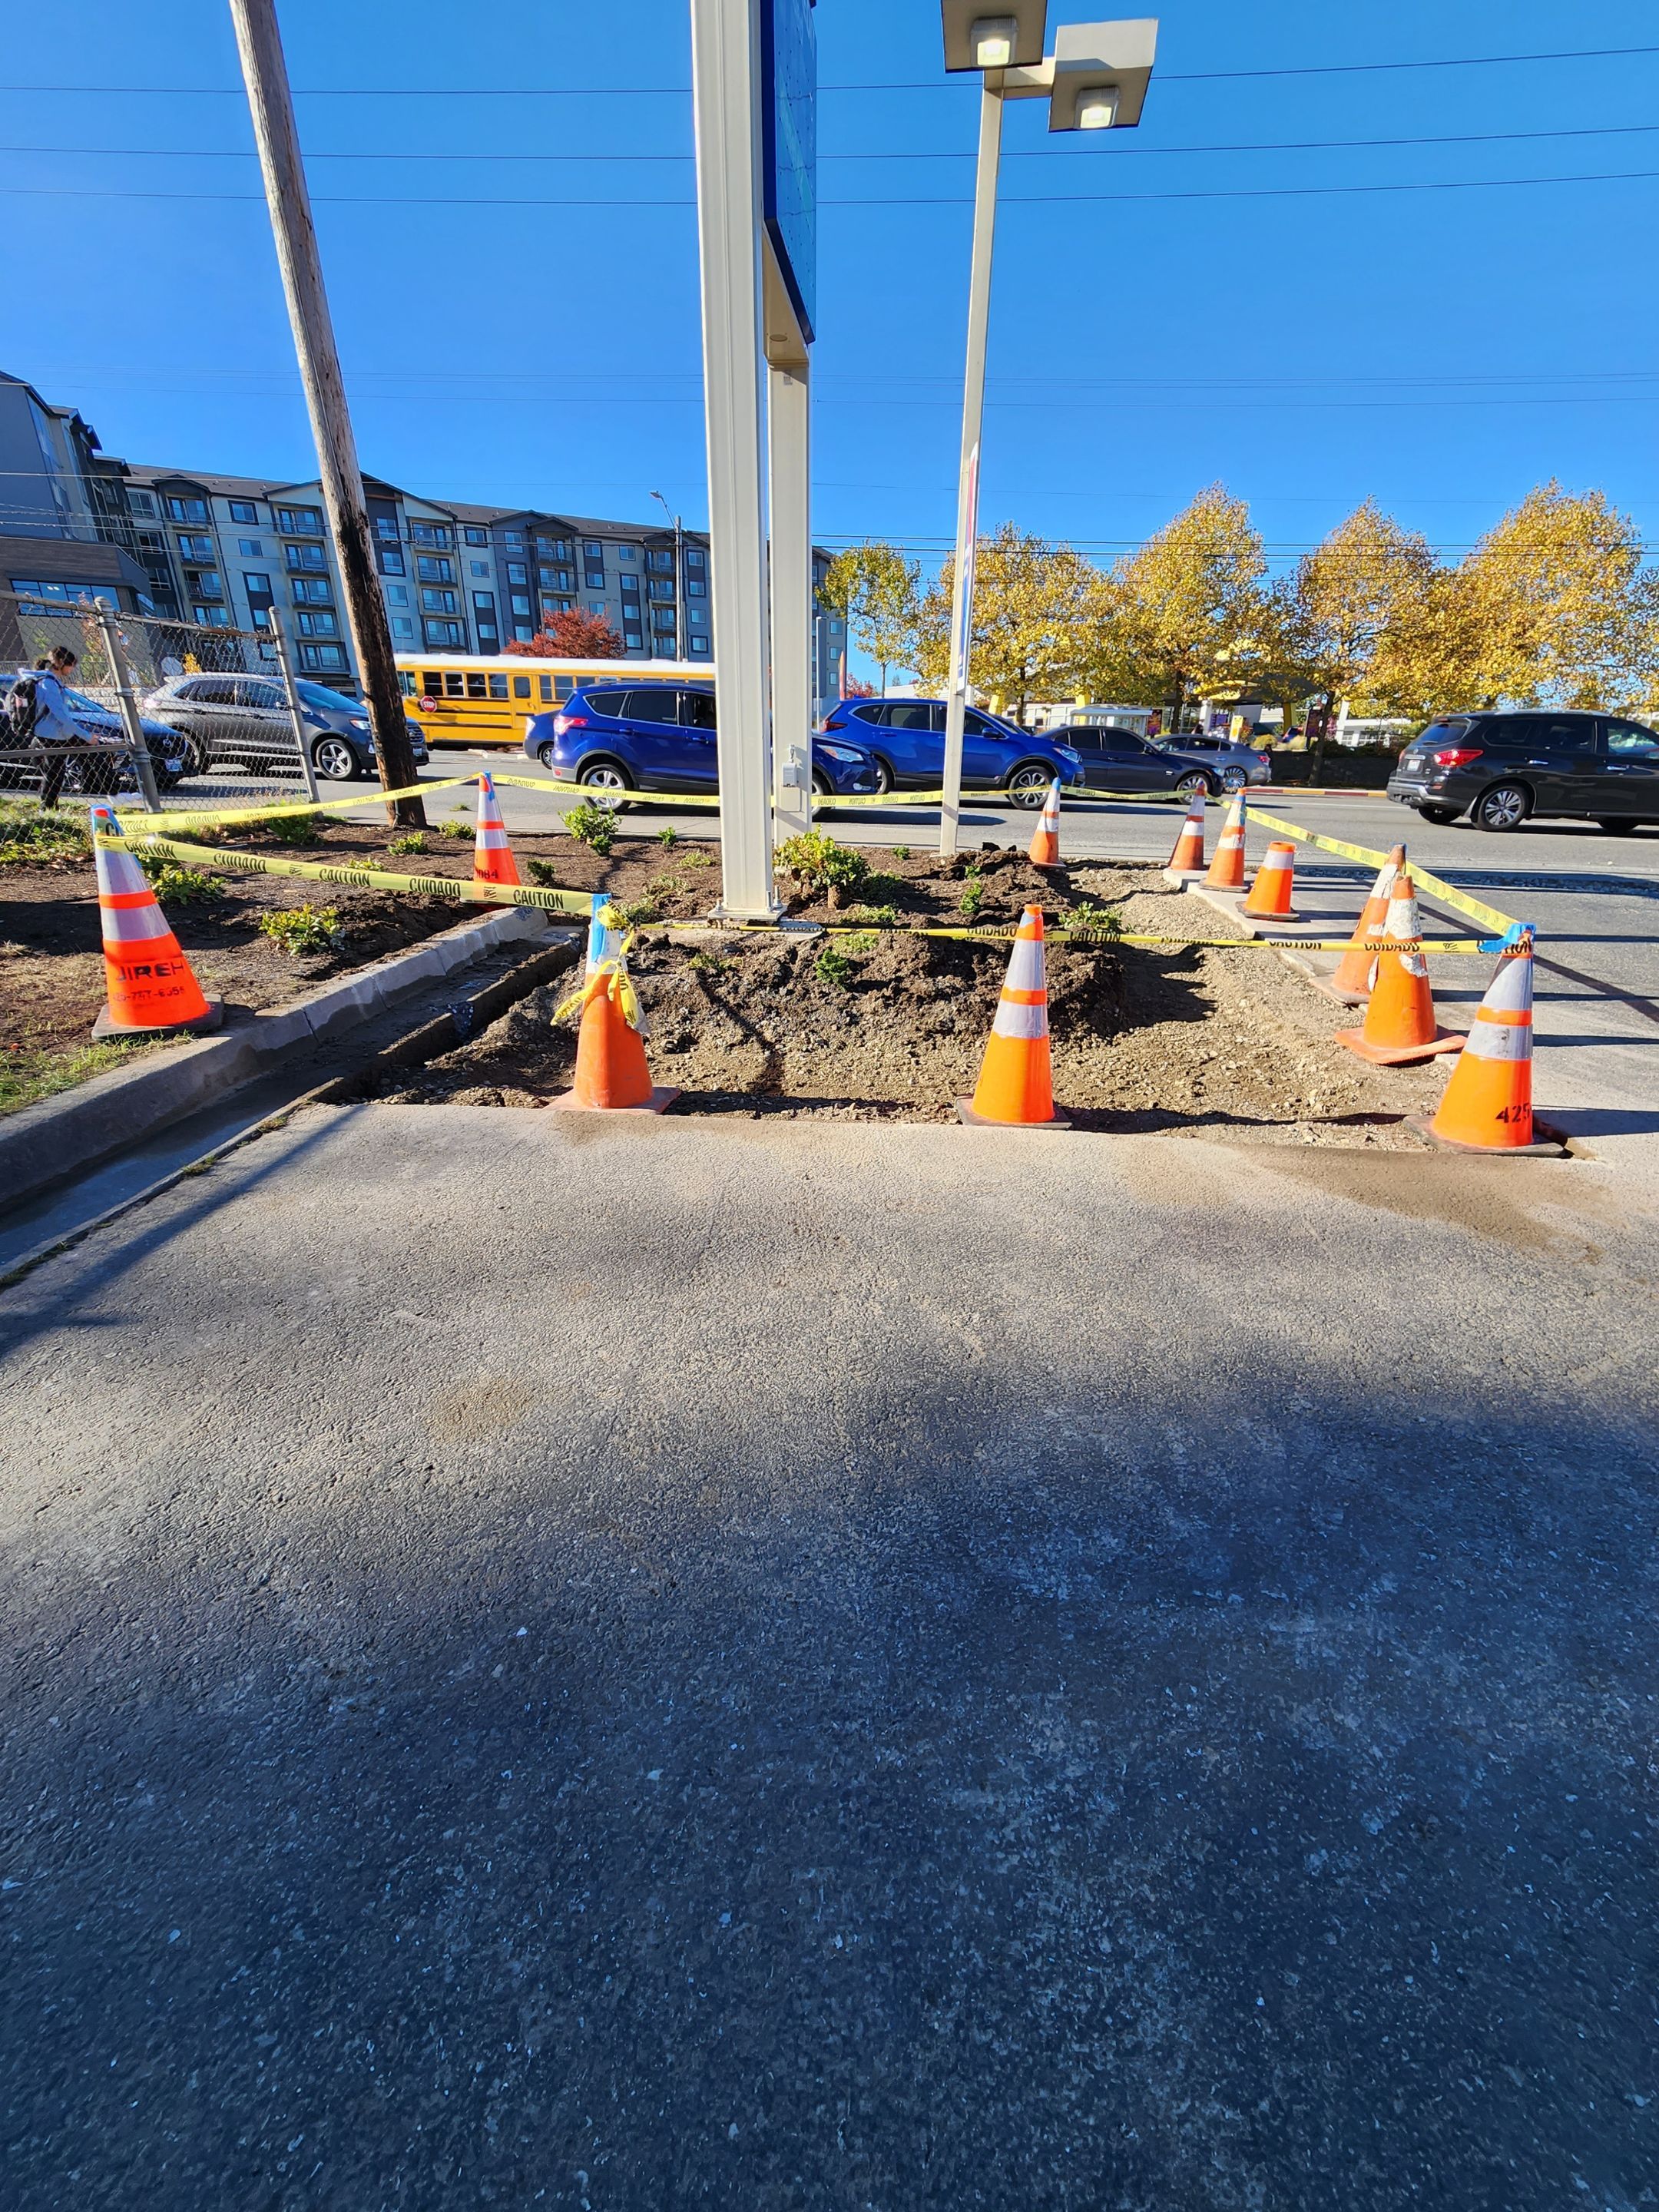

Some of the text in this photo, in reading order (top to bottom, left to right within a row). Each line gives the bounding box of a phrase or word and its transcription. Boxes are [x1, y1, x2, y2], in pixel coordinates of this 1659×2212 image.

[124, 840, 177, 859] CAUTION
[319, 868, 370, 886] CAUTION
[409, 878, 461, 897] CUIDADO
[513, 889, 564, 909] CAUTION
[117, 960, 184, 981] JIREH
